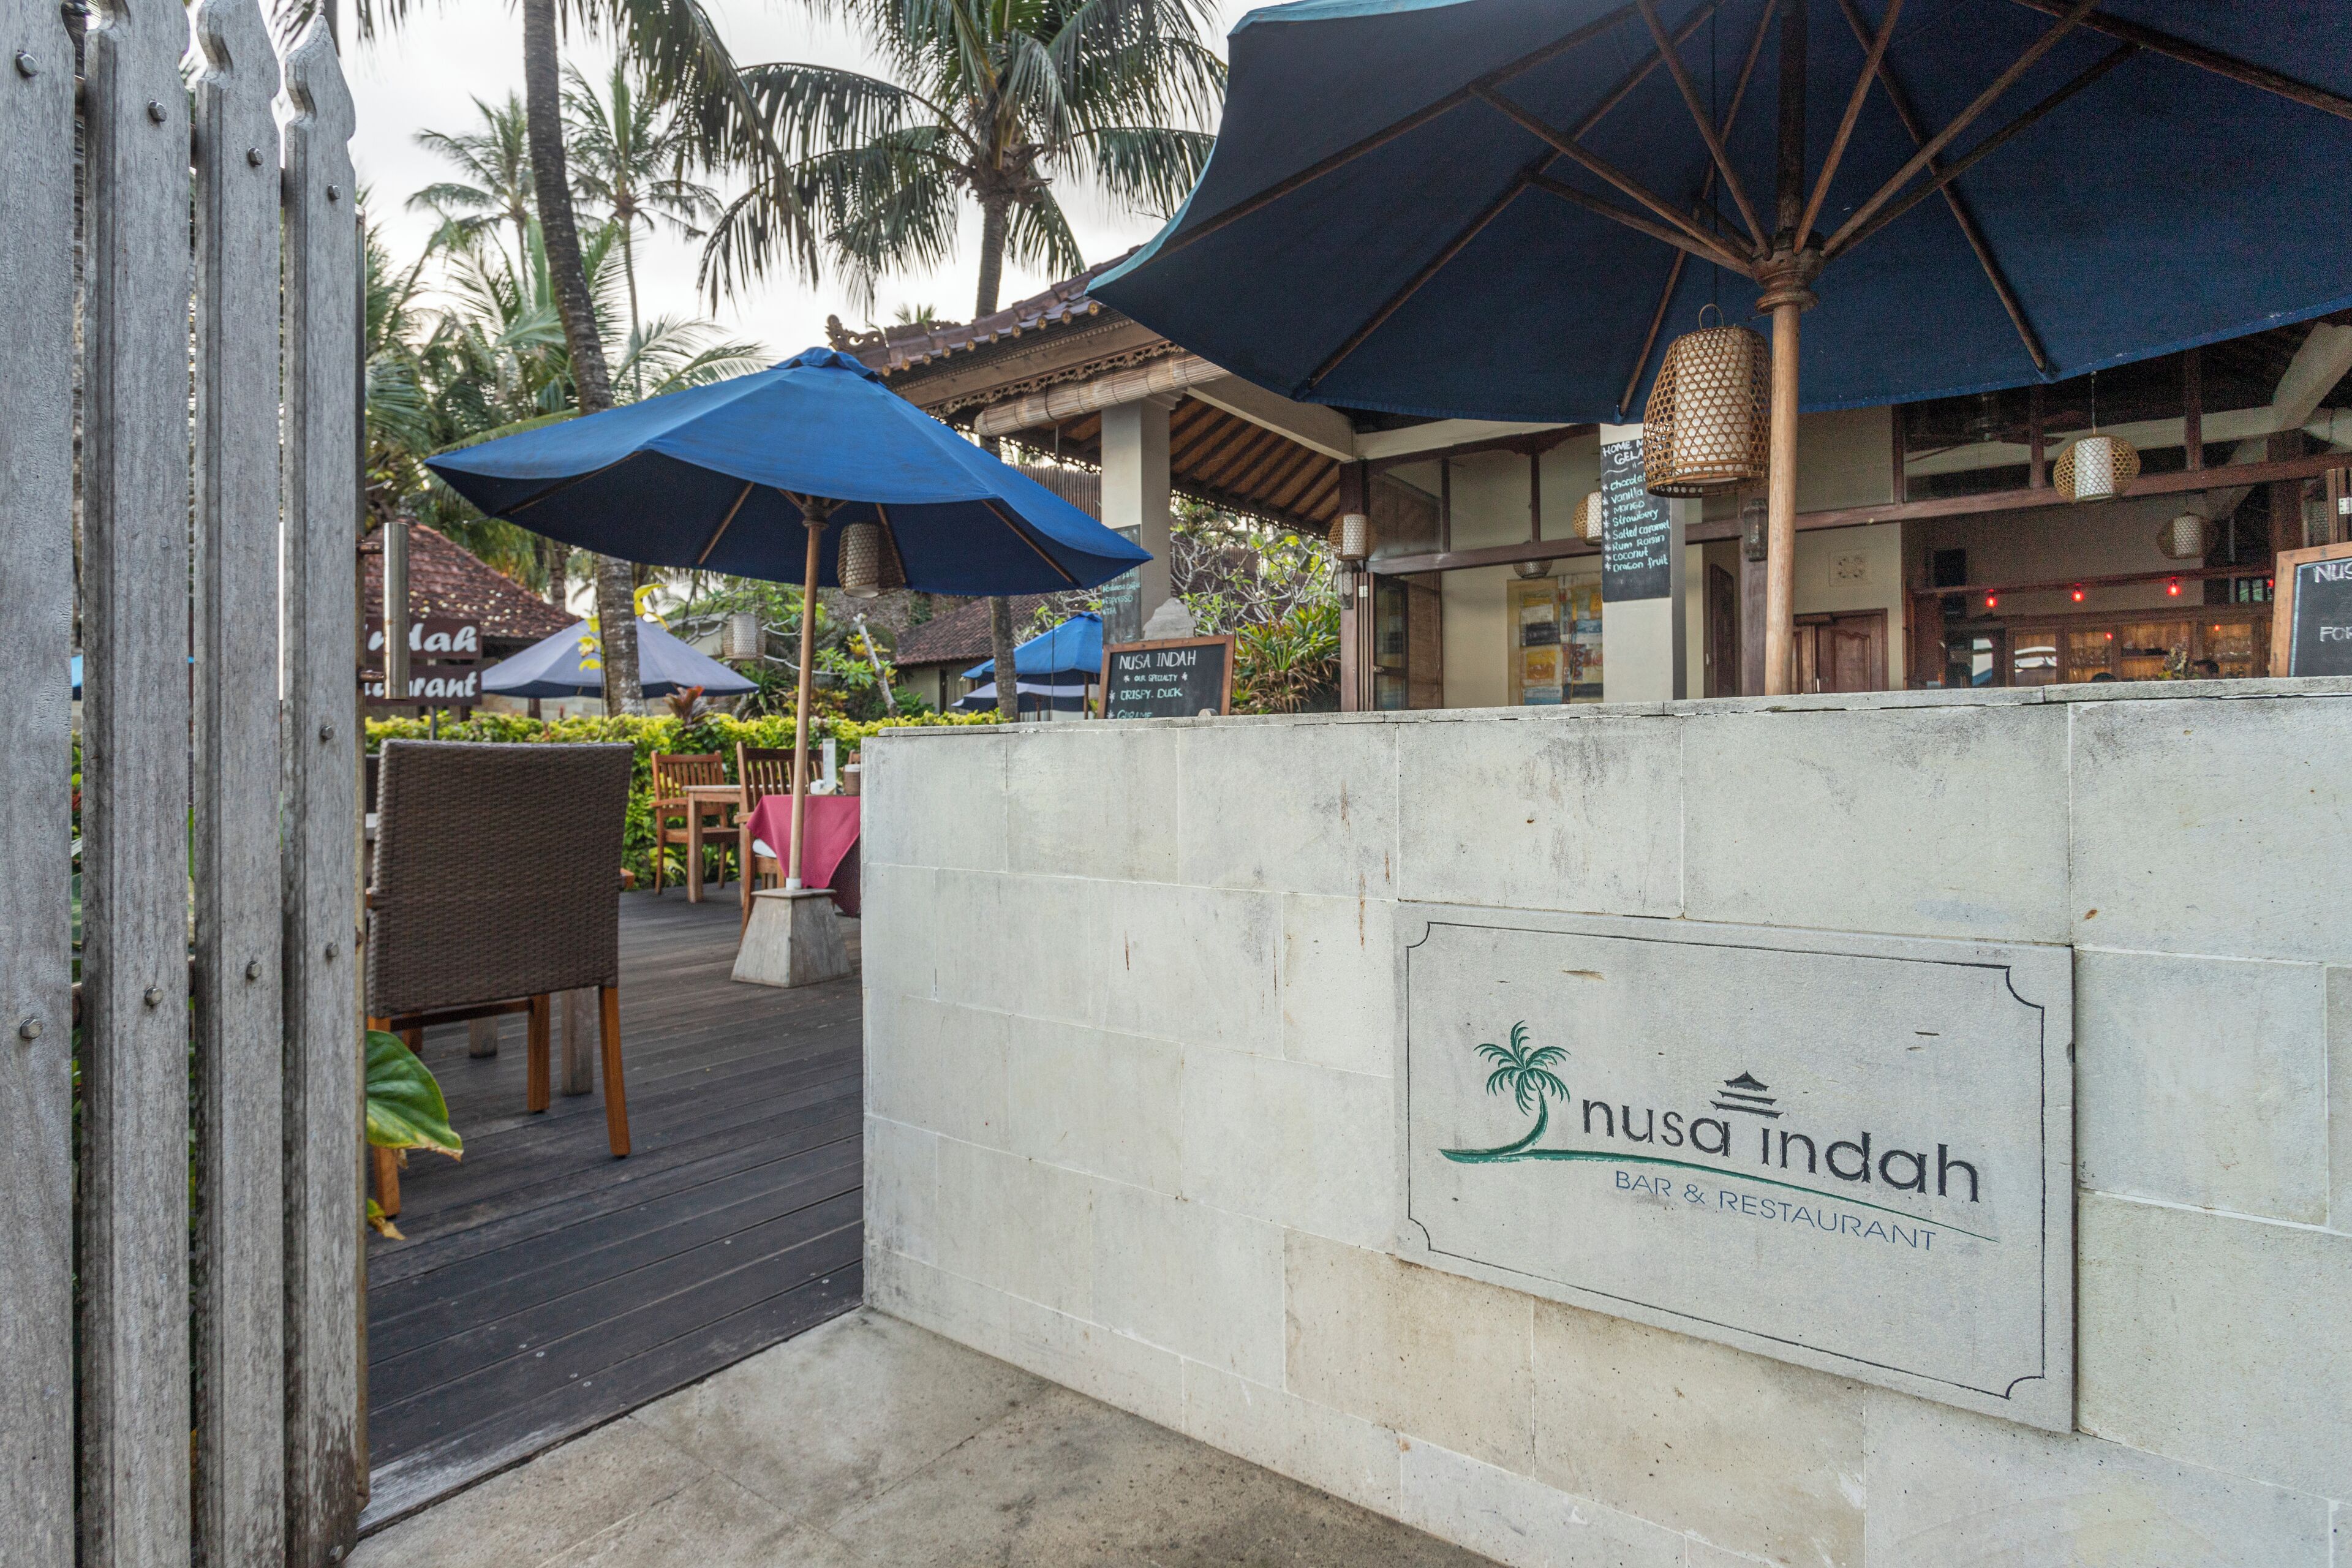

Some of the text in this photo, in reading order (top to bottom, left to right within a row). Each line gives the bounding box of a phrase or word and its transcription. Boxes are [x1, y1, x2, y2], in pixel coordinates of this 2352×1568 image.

[1602, 441, 1632, 457] HOME
[1614, 448, 1643, 465] GELA
[1613, 524, 1637, 540] Salted
[1612, 541, 1632, 551] Rum
[1648, 554, 1668, 570] fruit
[2313, 562, 2352, 583] NUS
[1118, 650, 1196, 670] NUSA INDAH
[1583, 1099, 1980, 1204] nusa indah
[1615, 1170, 1937, 1251] BAR & RESTAURANT
